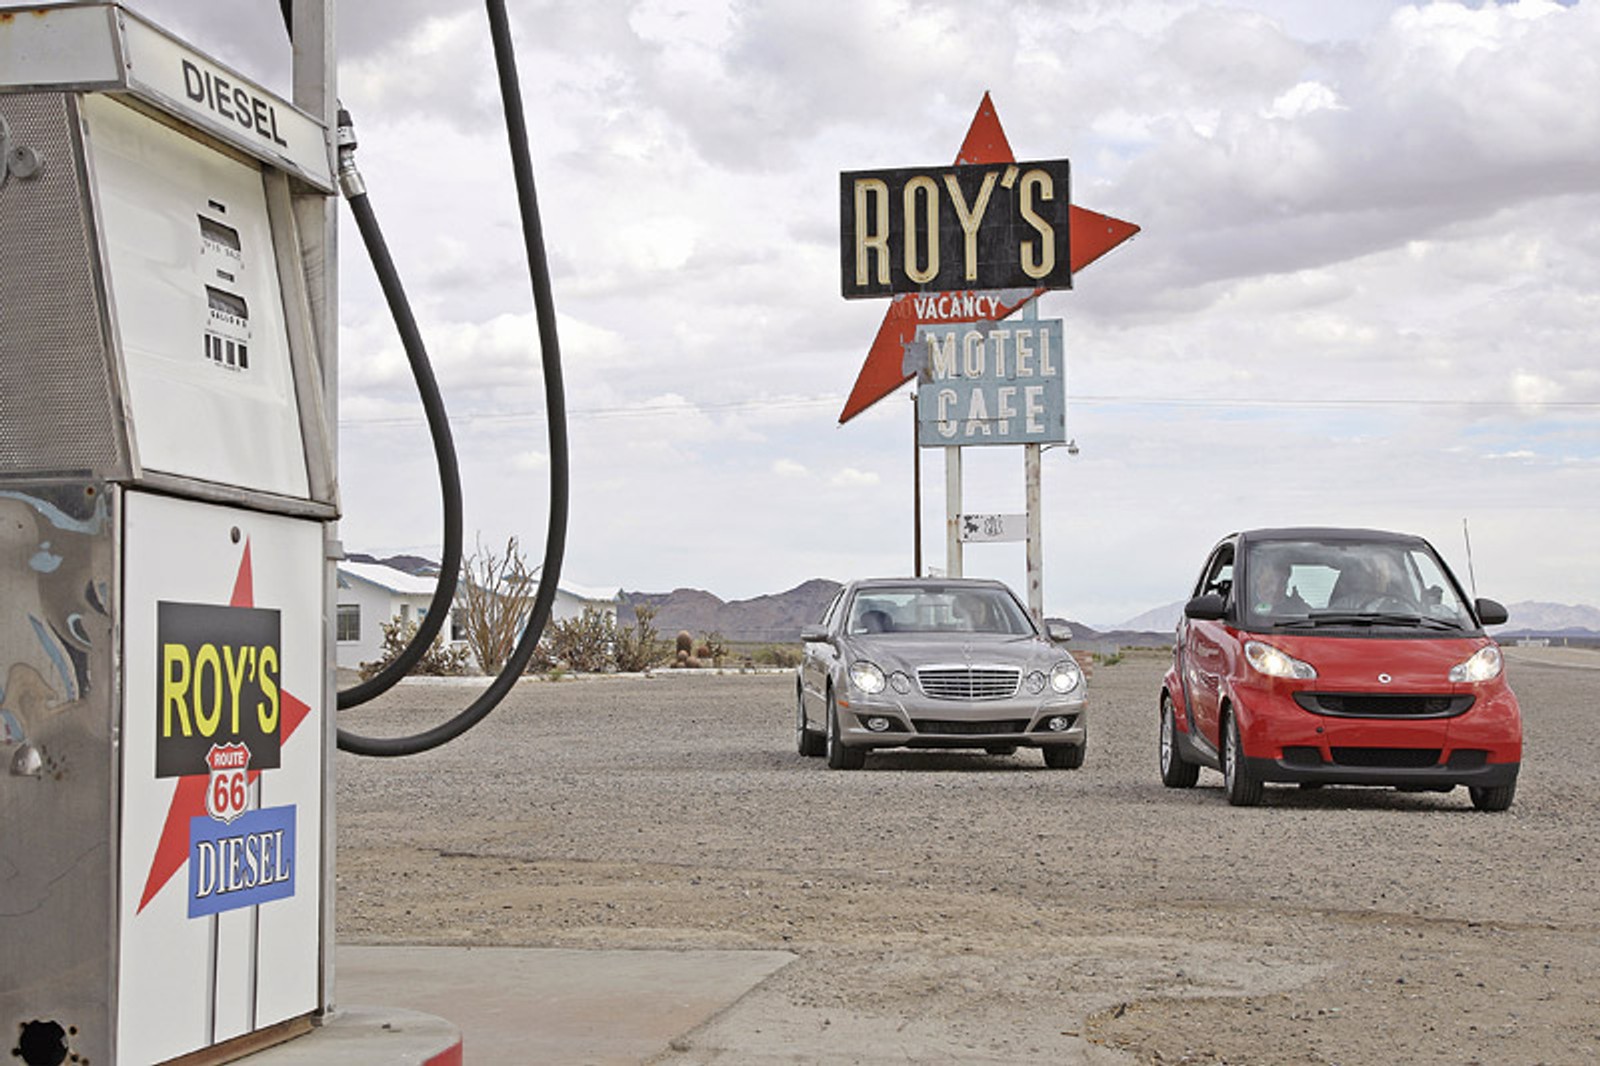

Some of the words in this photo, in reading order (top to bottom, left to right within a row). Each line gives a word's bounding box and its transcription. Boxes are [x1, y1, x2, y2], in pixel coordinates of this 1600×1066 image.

[182, 59, 288, 147] DIESEL
[854, 165, 1055, 285] ROY'S
[914, 296, 1000, 319] VACANCY
[926, 328, 1056, 379] MOTEL
[937, 386, 1045, 437] CAFE
[163, 643, 279, 737] ROY'S
[214, 751, 244, 767] ROUTE
[214, 772, 245, 813] 66
[196, 829, 290, 898] DIESEL
